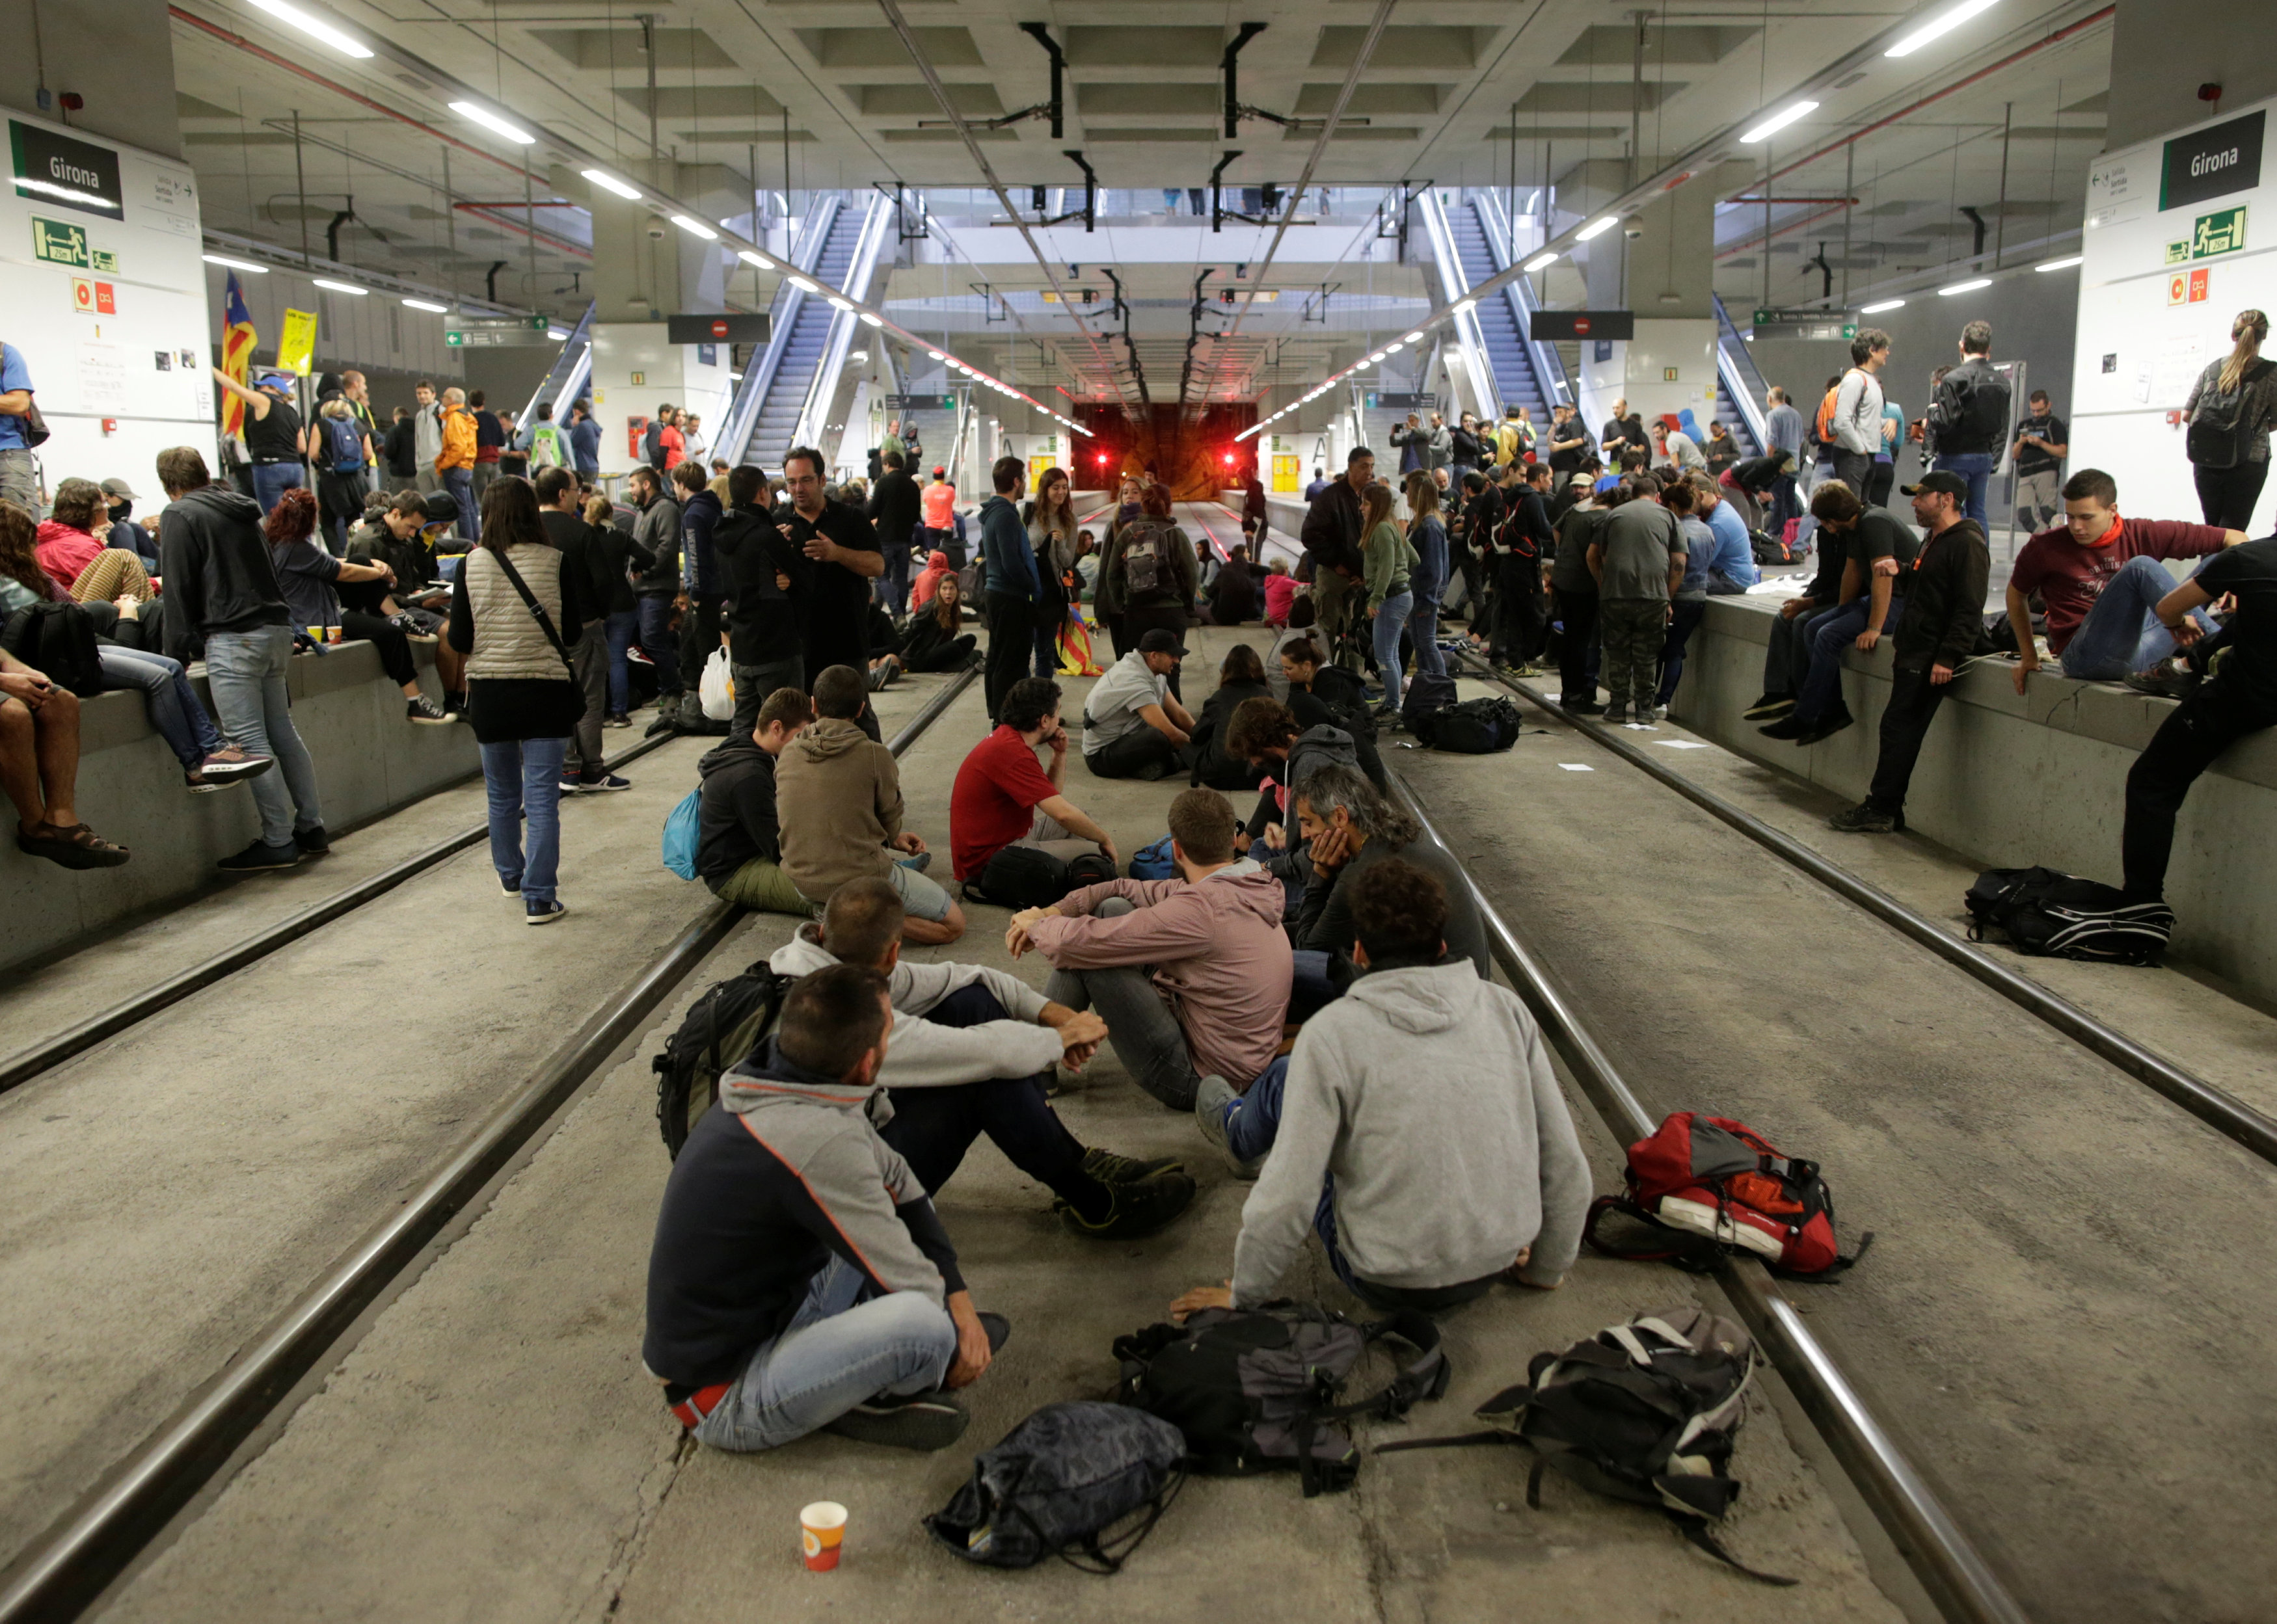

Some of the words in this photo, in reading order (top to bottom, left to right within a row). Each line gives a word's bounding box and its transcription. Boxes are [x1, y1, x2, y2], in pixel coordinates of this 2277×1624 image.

[2191, 147, 2238, 177] Girona
[50, 156, 99, 189] Girona
[2110, 178, 2127, 188] Sortida
[2213, 240, 2226, 250] 25m
[55, 248, 68, 259] 25m
